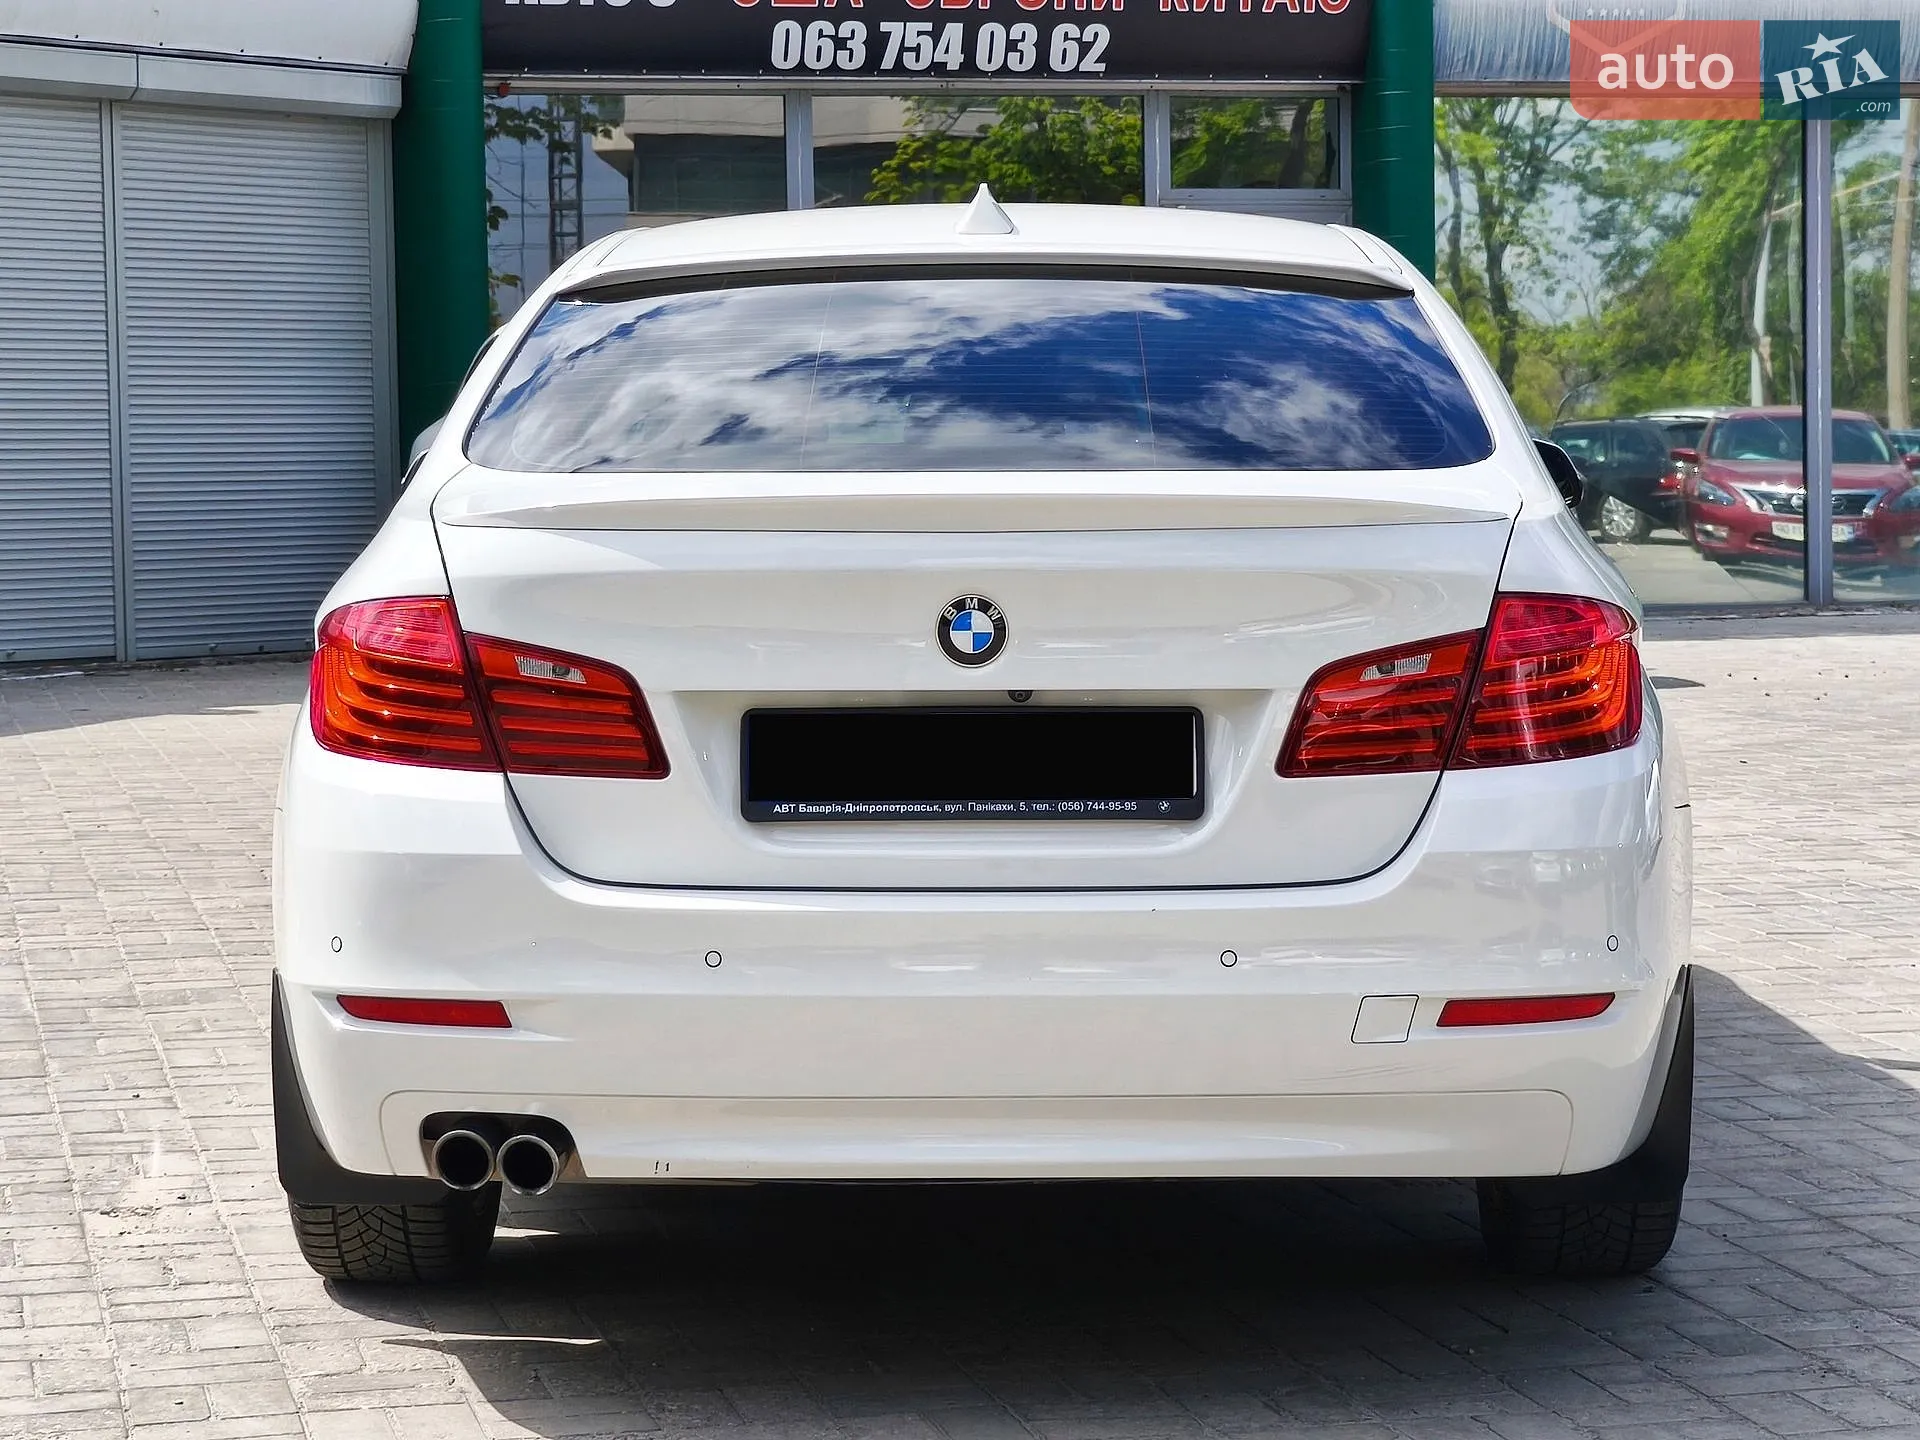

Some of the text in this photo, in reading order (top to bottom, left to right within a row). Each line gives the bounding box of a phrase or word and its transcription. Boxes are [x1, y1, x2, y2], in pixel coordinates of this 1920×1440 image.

[771, 20, 1111, 72] 063 754 03 62
[943, 597, 1002, 621] BMW
[773, 803, 797, 813] АВТ
[1058, 801, 1085, 813] (056)
[1086, 801, 1138, 812] 744-95-95
